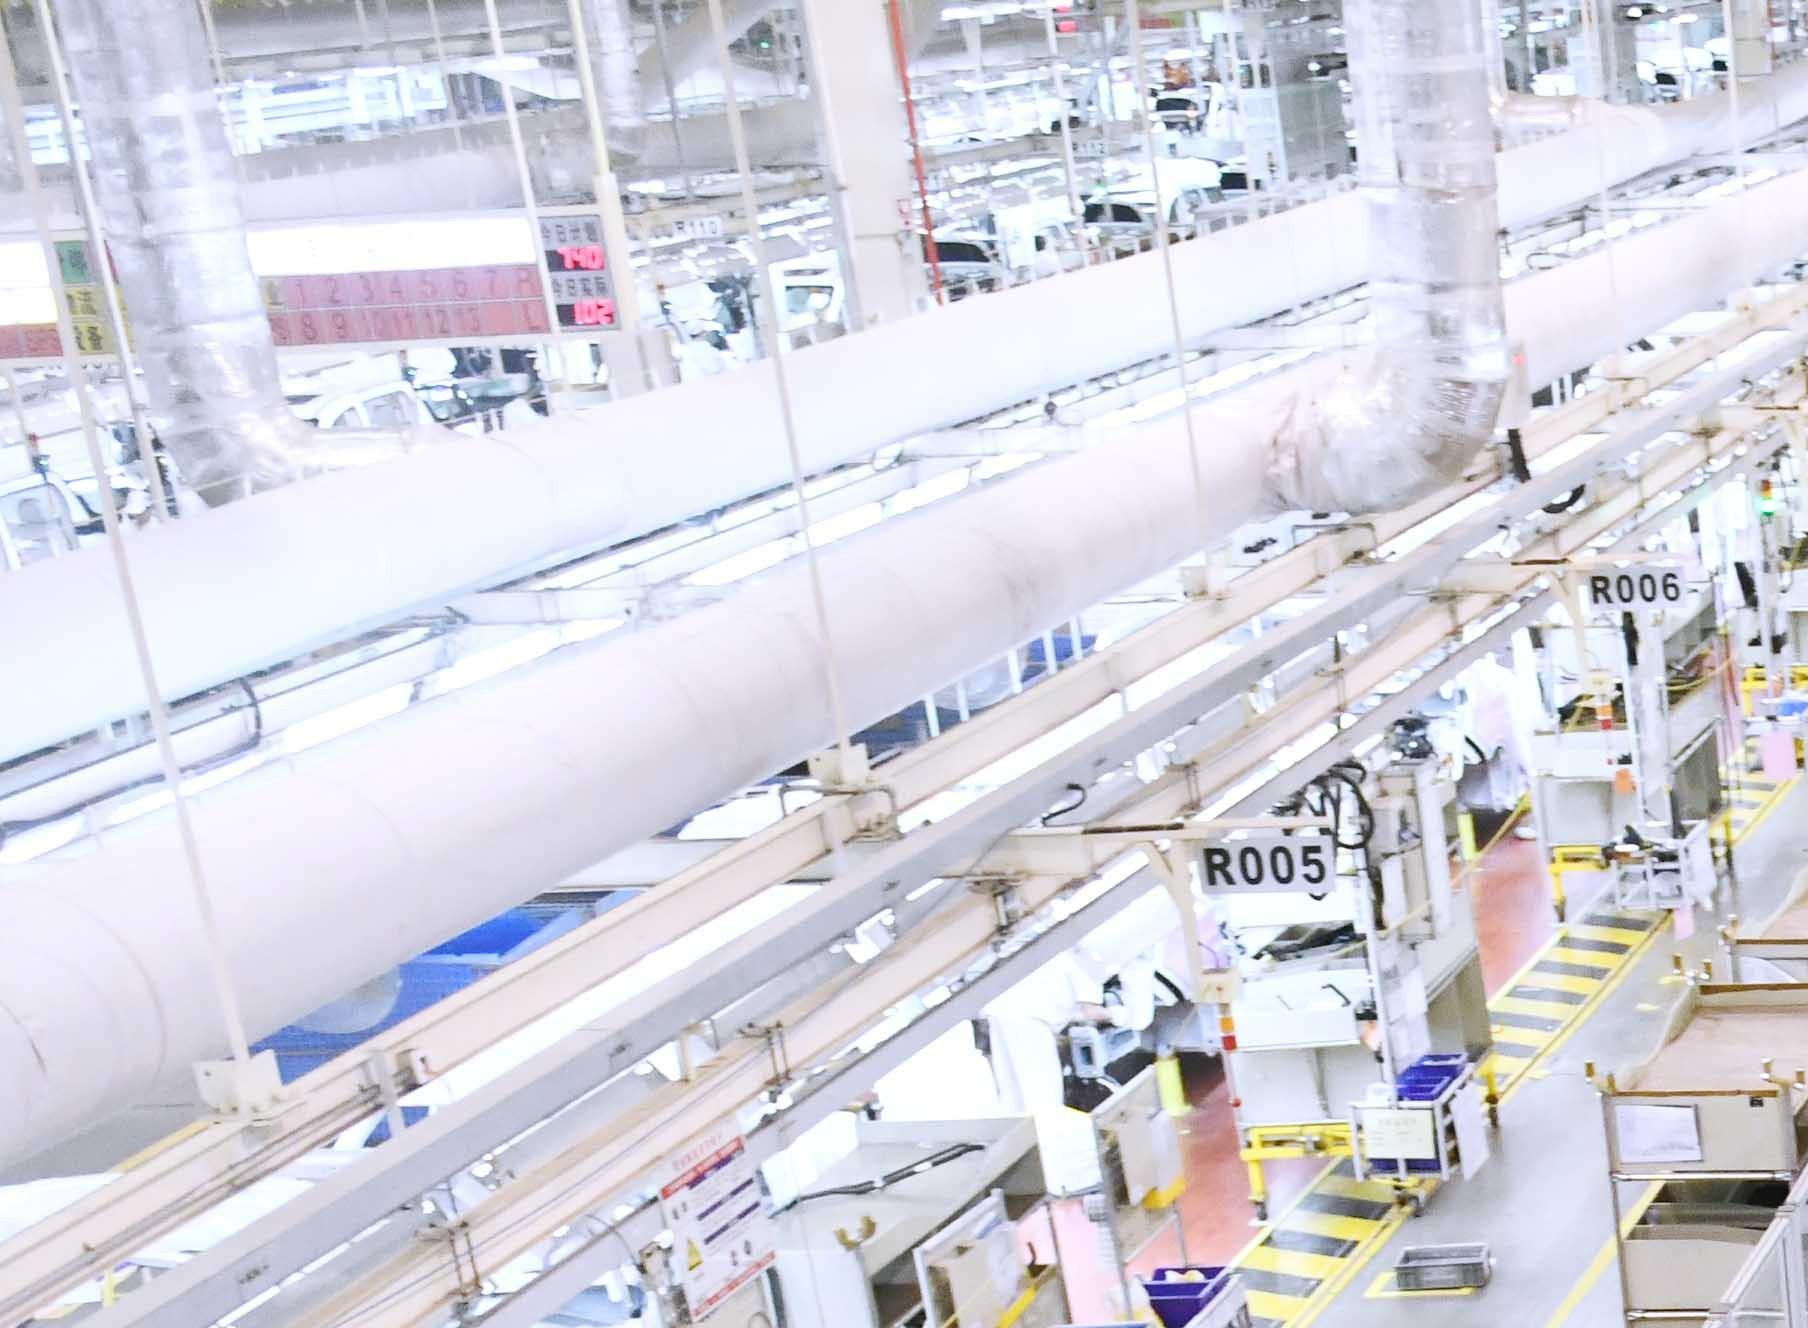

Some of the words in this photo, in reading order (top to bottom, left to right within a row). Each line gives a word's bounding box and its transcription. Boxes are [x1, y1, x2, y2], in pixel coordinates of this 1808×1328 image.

[558, 245, 605, 271] 740
[424, 308, 449, 335] 12
[573, 298, 615, 325] 102
[1590, 572, 1681, 604] R006
[1203, 845, 1326, 886] R005
